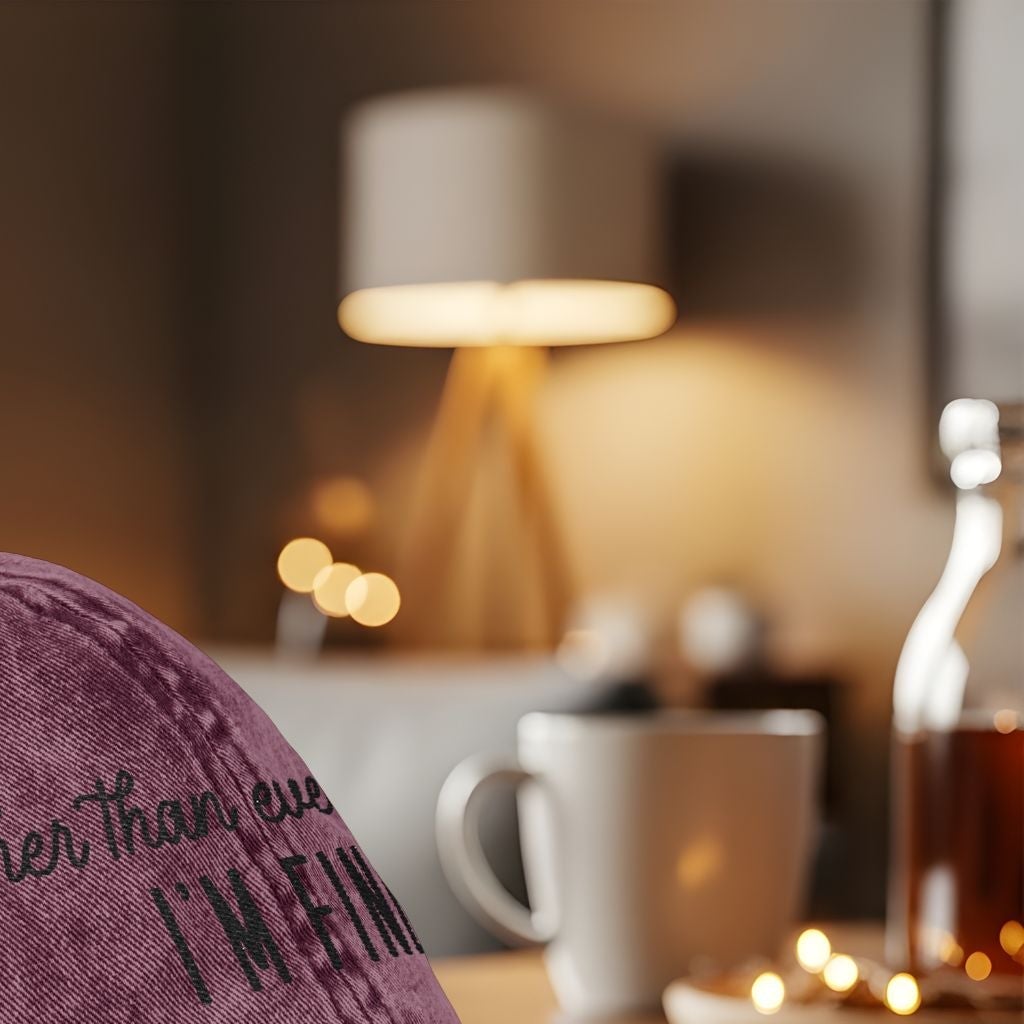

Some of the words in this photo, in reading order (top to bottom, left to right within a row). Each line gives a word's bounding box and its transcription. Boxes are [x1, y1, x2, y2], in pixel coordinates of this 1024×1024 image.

[75, 770, 239, 860] than
[252, 775, 334, 823] eve
[151, 868, 293, 1005] I'M
[280, 845, 425, 971] FIN
